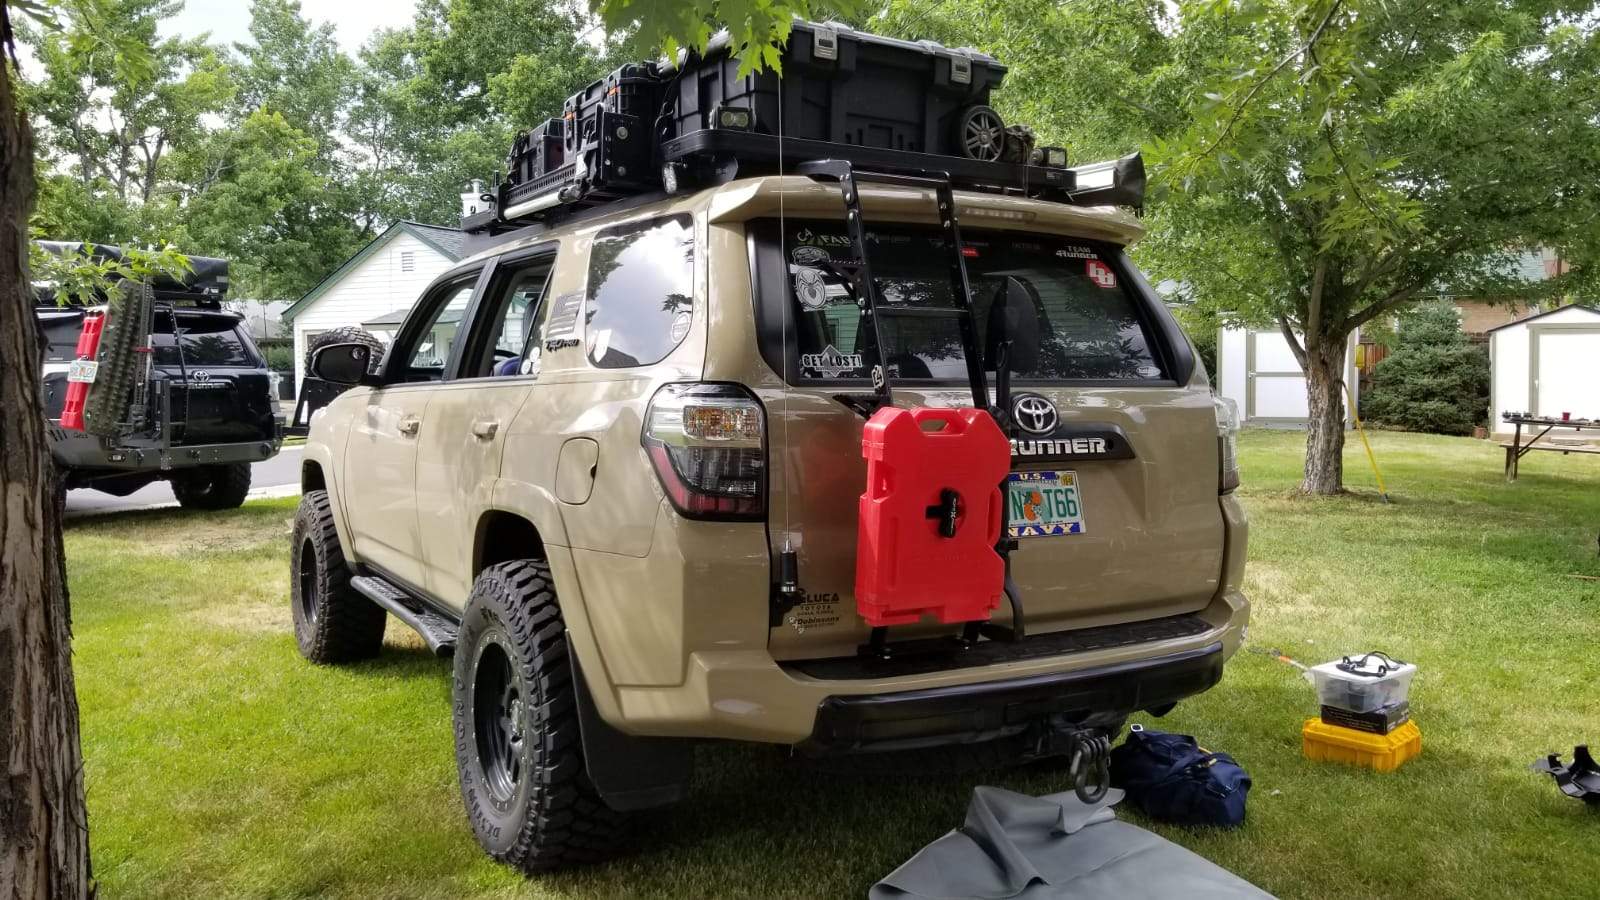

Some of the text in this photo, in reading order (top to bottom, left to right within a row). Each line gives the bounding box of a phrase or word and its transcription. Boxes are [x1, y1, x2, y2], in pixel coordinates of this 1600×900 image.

[1064, 245, 1091, 253] TEAM
[803, 355, 862, 367] GET LOST!
[1008, 523, 1074, 537] NAVY
